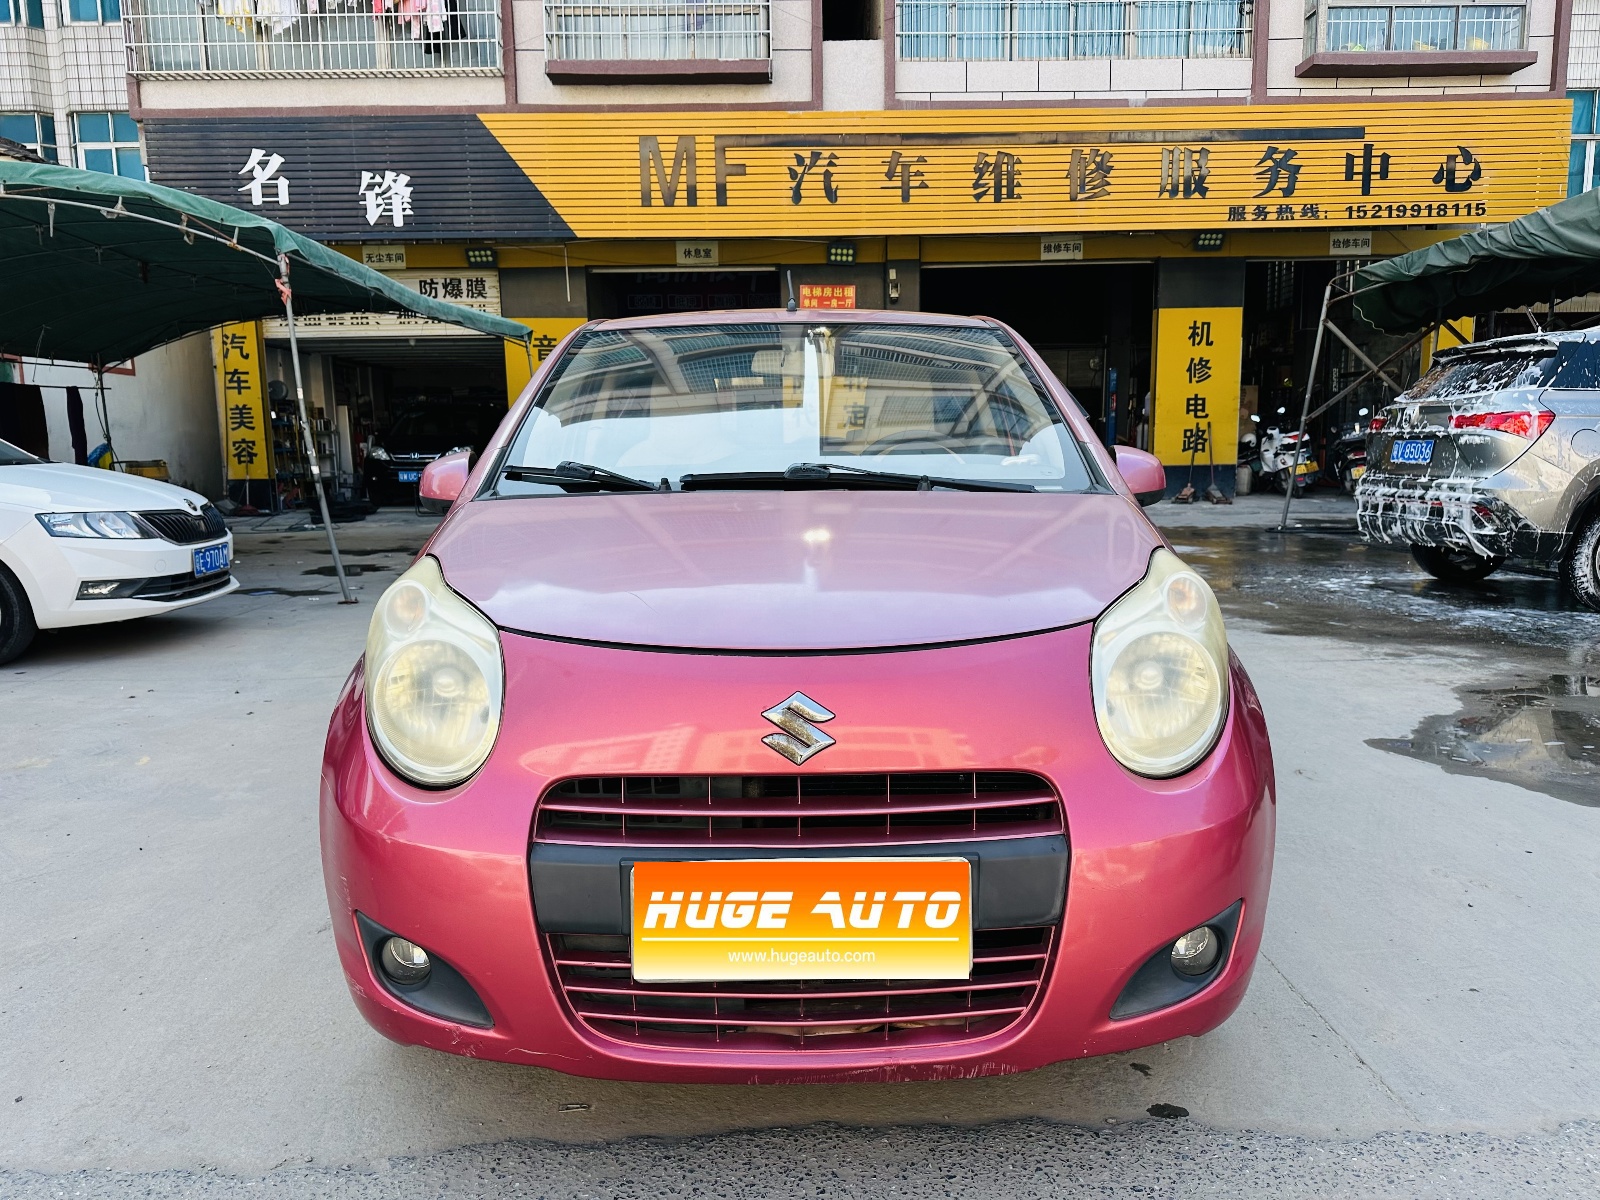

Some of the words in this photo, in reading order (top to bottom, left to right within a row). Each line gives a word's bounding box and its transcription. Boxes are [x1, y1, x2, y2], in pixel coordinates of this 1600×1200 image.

[639, 136, 747, 207] MF
[787, 143, 1482, 206] 汽车维修服务中心
[238, 148, 414, 227] 名锋
[1345, 202, 1487, 220] 15219918115
[1043, 243, 1082, 254] 维修车间
[1332, 238, 1371, 249] 检修车间
[365, 252, 405, 264] 无尘车间
[683, 248, 712, 259] 休息室
[419, 277, 488, 300] 防爆膜
[802, 286, 854, 298] 电梯房出租
[1182, 320, 1214, 453] 机修电路
[222, 333, 258, 465] 汽车美容
